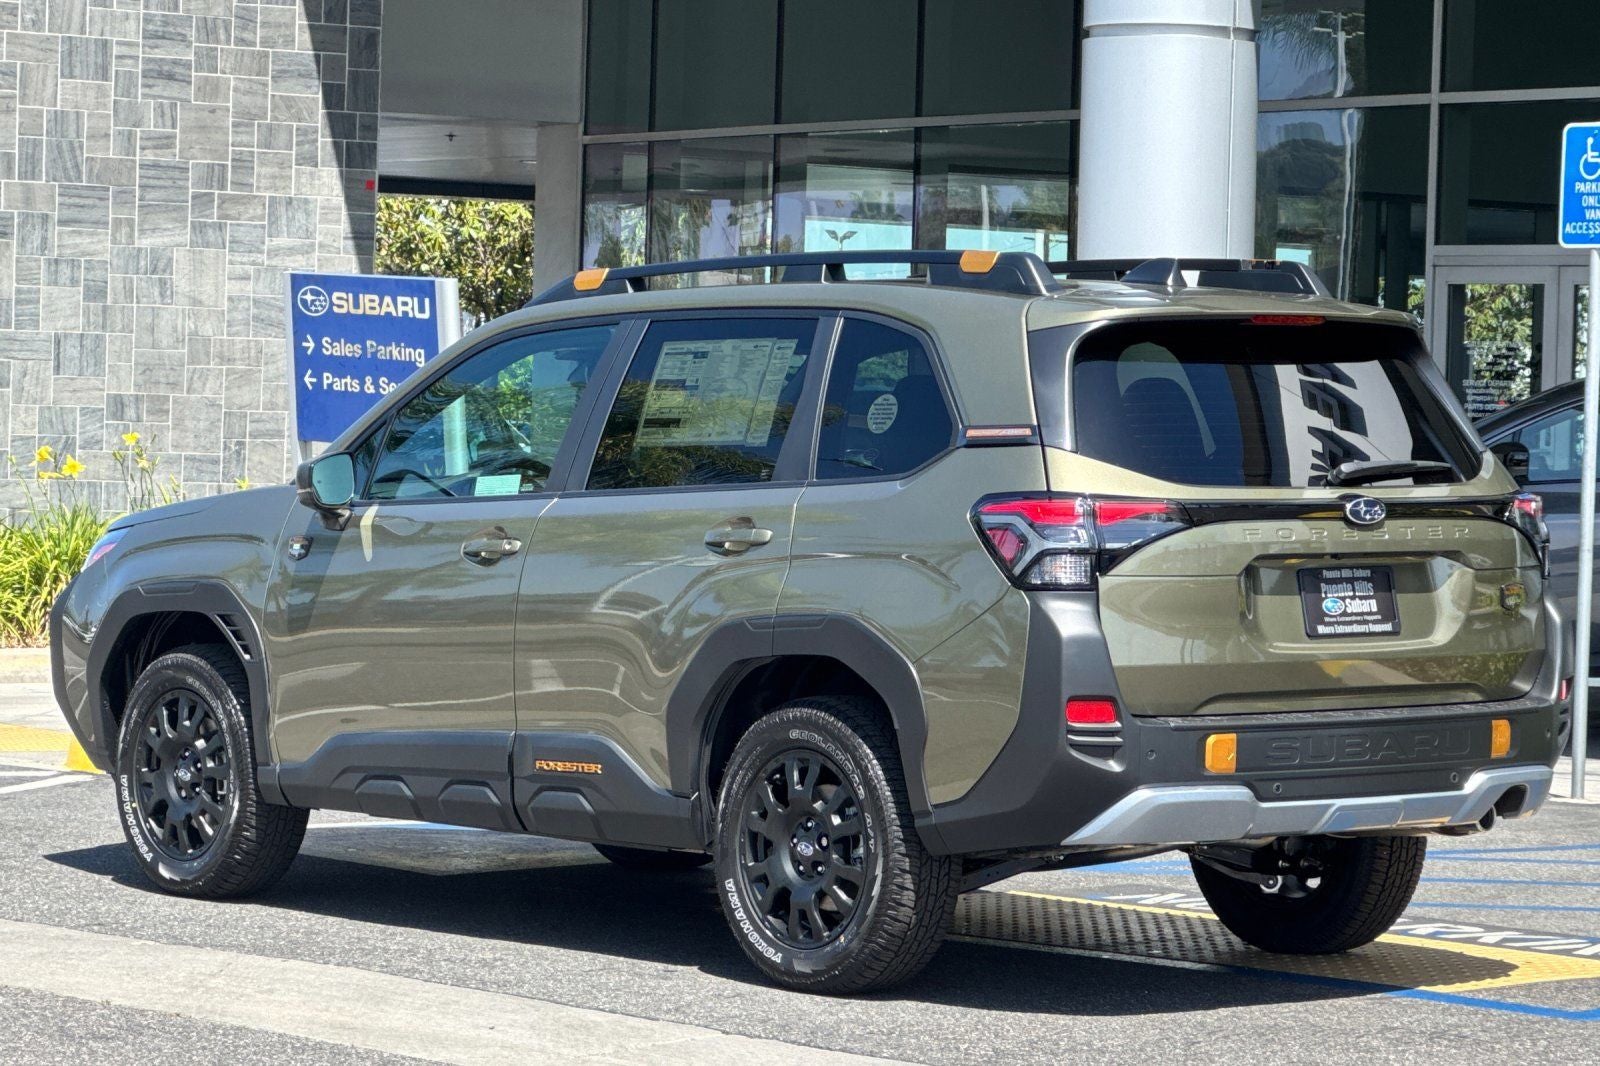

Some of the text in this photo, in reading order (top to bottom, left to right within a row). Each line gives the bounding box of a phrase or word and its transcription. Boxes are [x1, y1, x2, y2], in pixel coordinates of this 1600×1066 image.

[332, 292, 430, 319] SUBARU
[321, 336, 425, 367] Sales Parking
[323, 372, 360, 393] Parts
[364, 375, 376, 394] &
[1242, 526, 1470, 542] FORESTER
[1322, 568, 1371, 578] Puente Hills Subaru
[1320, 580, 1374, 598] Puente Hills
[1345, 597, 1378, 613] Subaru
[1335, 623, 1369, 633] Extraordinary
[1265, 728, 1472, 766] SUBARU
[534, 760, 602, 774] FORESTER
[789, 728, 865, 800] GEOLANDAR
[120, 774, 154, 862] YOKOHAMA
[724, 878, 783, 963] YOKOHAMA
